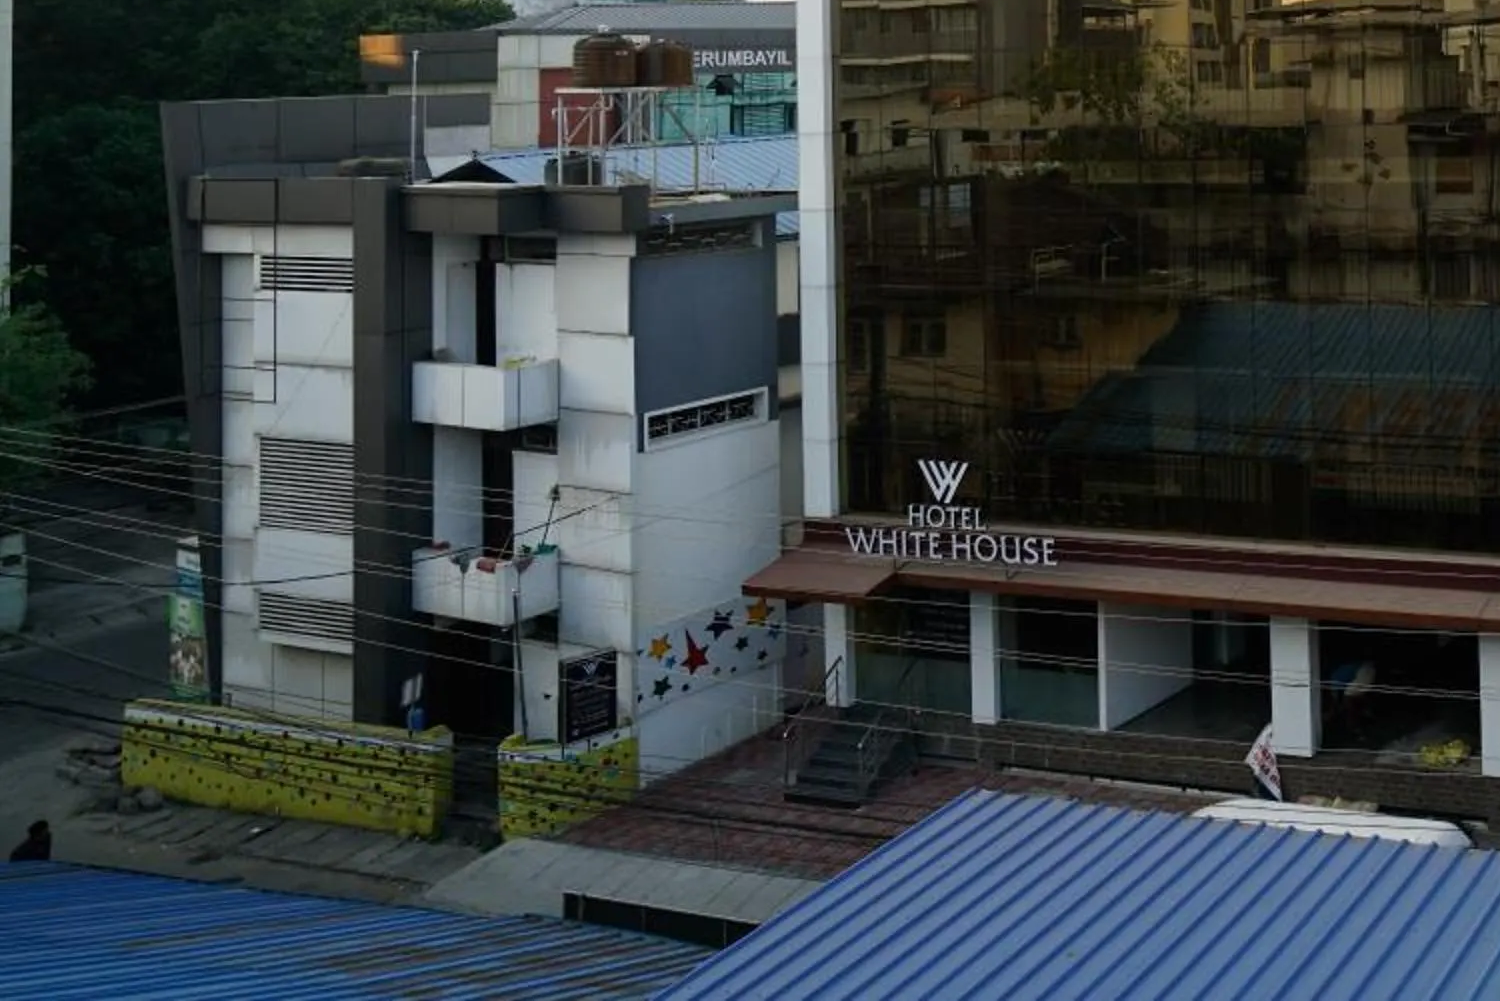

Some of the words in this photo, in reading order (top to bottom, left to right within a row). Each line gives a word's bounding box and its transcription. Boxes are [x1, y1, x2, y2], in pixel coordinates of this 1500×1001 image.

[907, 503, 989, 531] HOTEL
[844, 526, 944, 561] WHITE
[951, 533, 1059, 567] HOUSE
